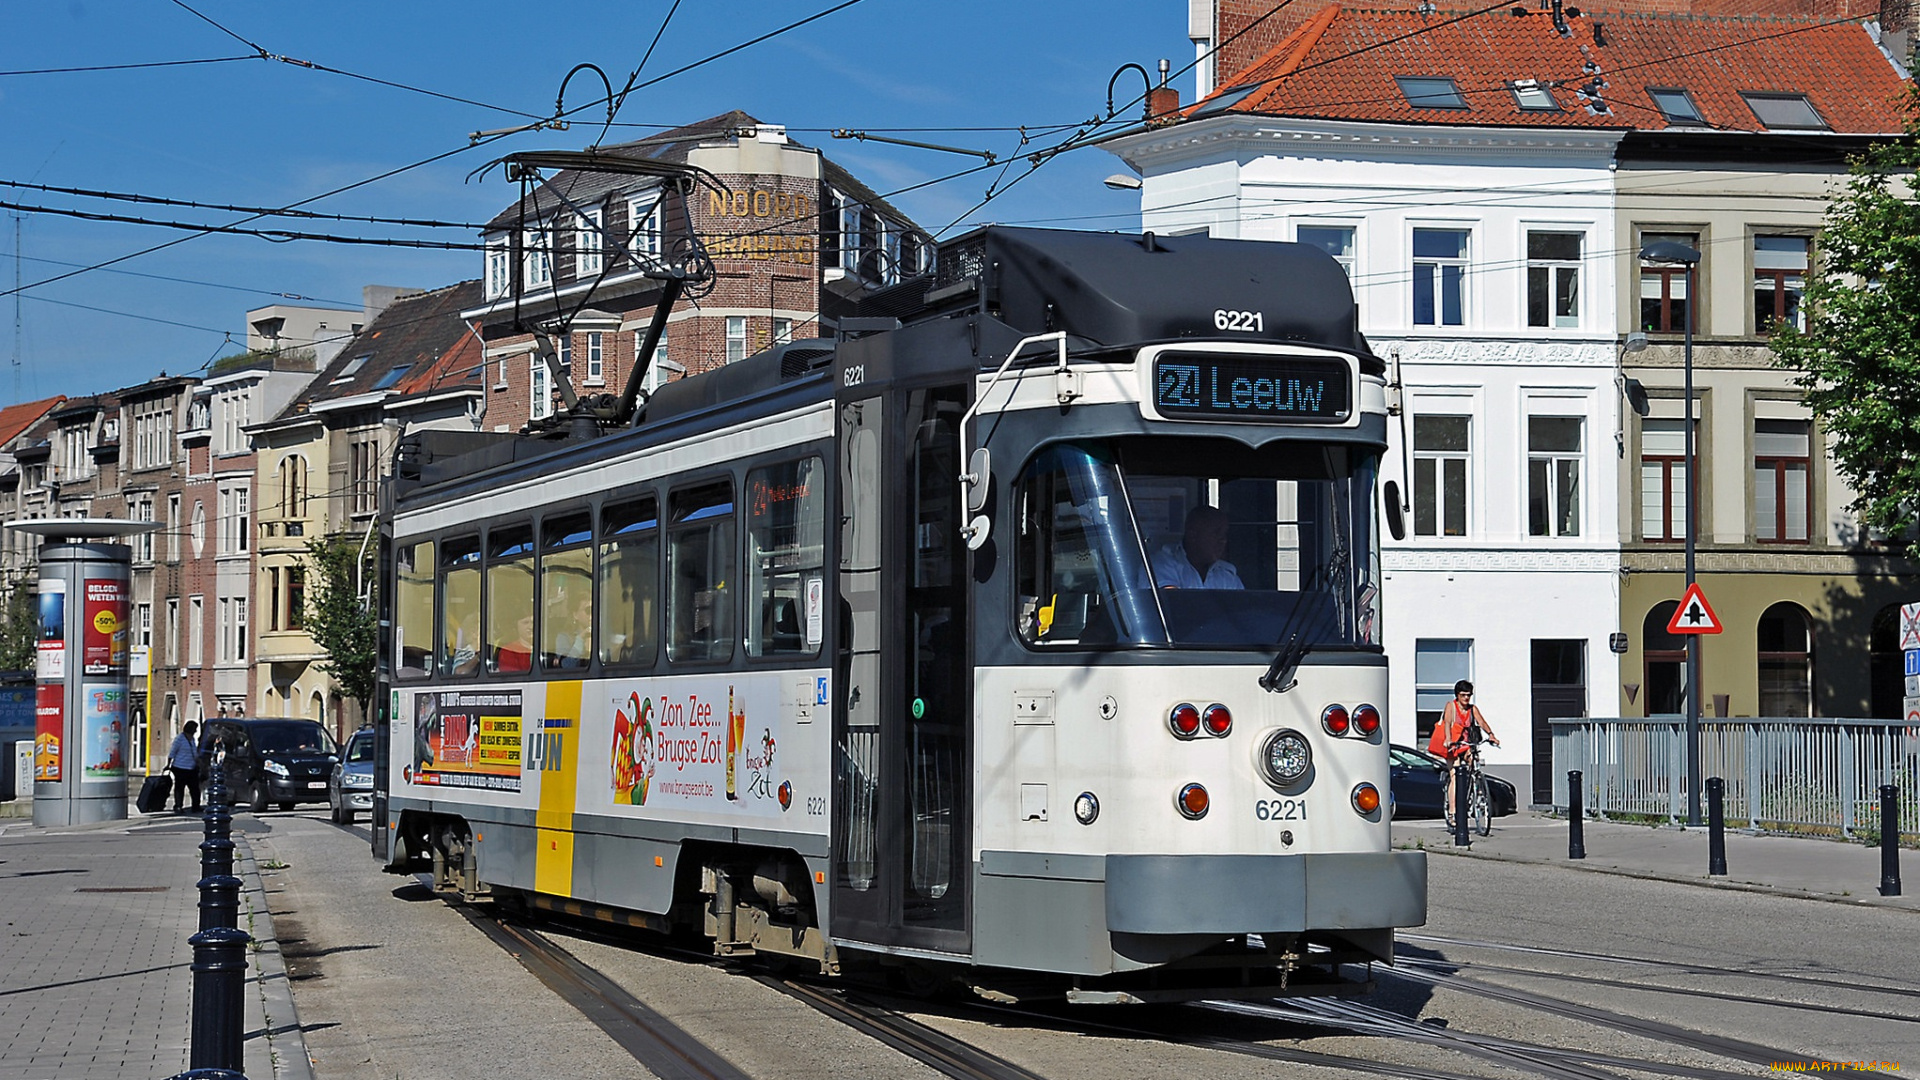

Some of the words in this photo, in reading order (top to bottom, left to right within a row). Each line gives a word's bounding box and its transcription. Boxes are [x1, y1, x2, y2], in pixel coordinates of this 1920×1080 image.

[709, 189, 809, 219] NOORD
[1214, 309, 1264, 332] 6221
[844, 364, 865, 387] 6221
[1159, 367, 1198, 405] 24
[1212, 366, 1324, 411] Leeuw
[87, 593, 115, 602] WETEN
[660, 696, 686, 730] Zon,
[689, 695, 721, 727] Zee...
[444, 714, 467, 748] DINO
[657, 731, 698, 772] Brugse
[700, 732, 722, 764] Zot
[659, 779, 713, 799] www.brugsezot.be
[807, 797, 826, 816] 6221
[1255, 799, 1307, 821] 6221
